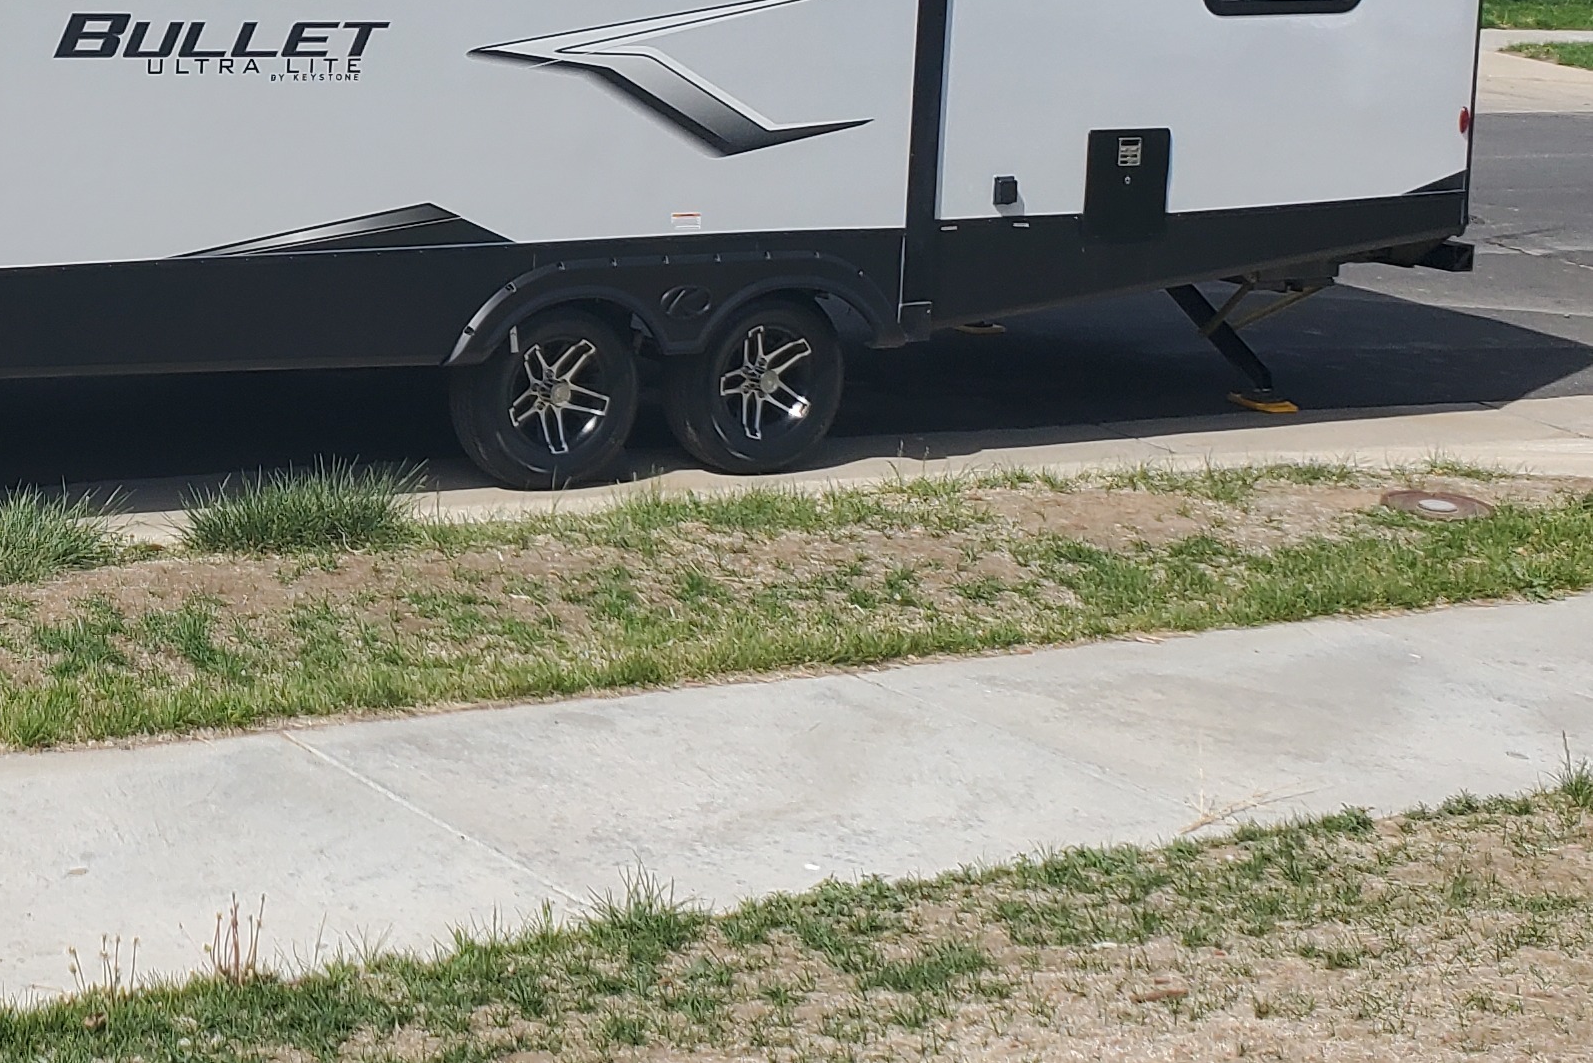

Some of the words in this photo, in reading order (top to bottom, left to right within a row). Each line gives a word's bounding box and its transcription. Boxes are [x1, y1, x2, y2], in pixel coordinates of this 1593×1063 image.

[53, 12, 391, 59] BULLET
[147, 58, 260, 74] ULTRA
[286, 58, 362, 74] LITE
[270, 74, 285, 82] BY
[293, 73, 360, 82] KEYSTONE
